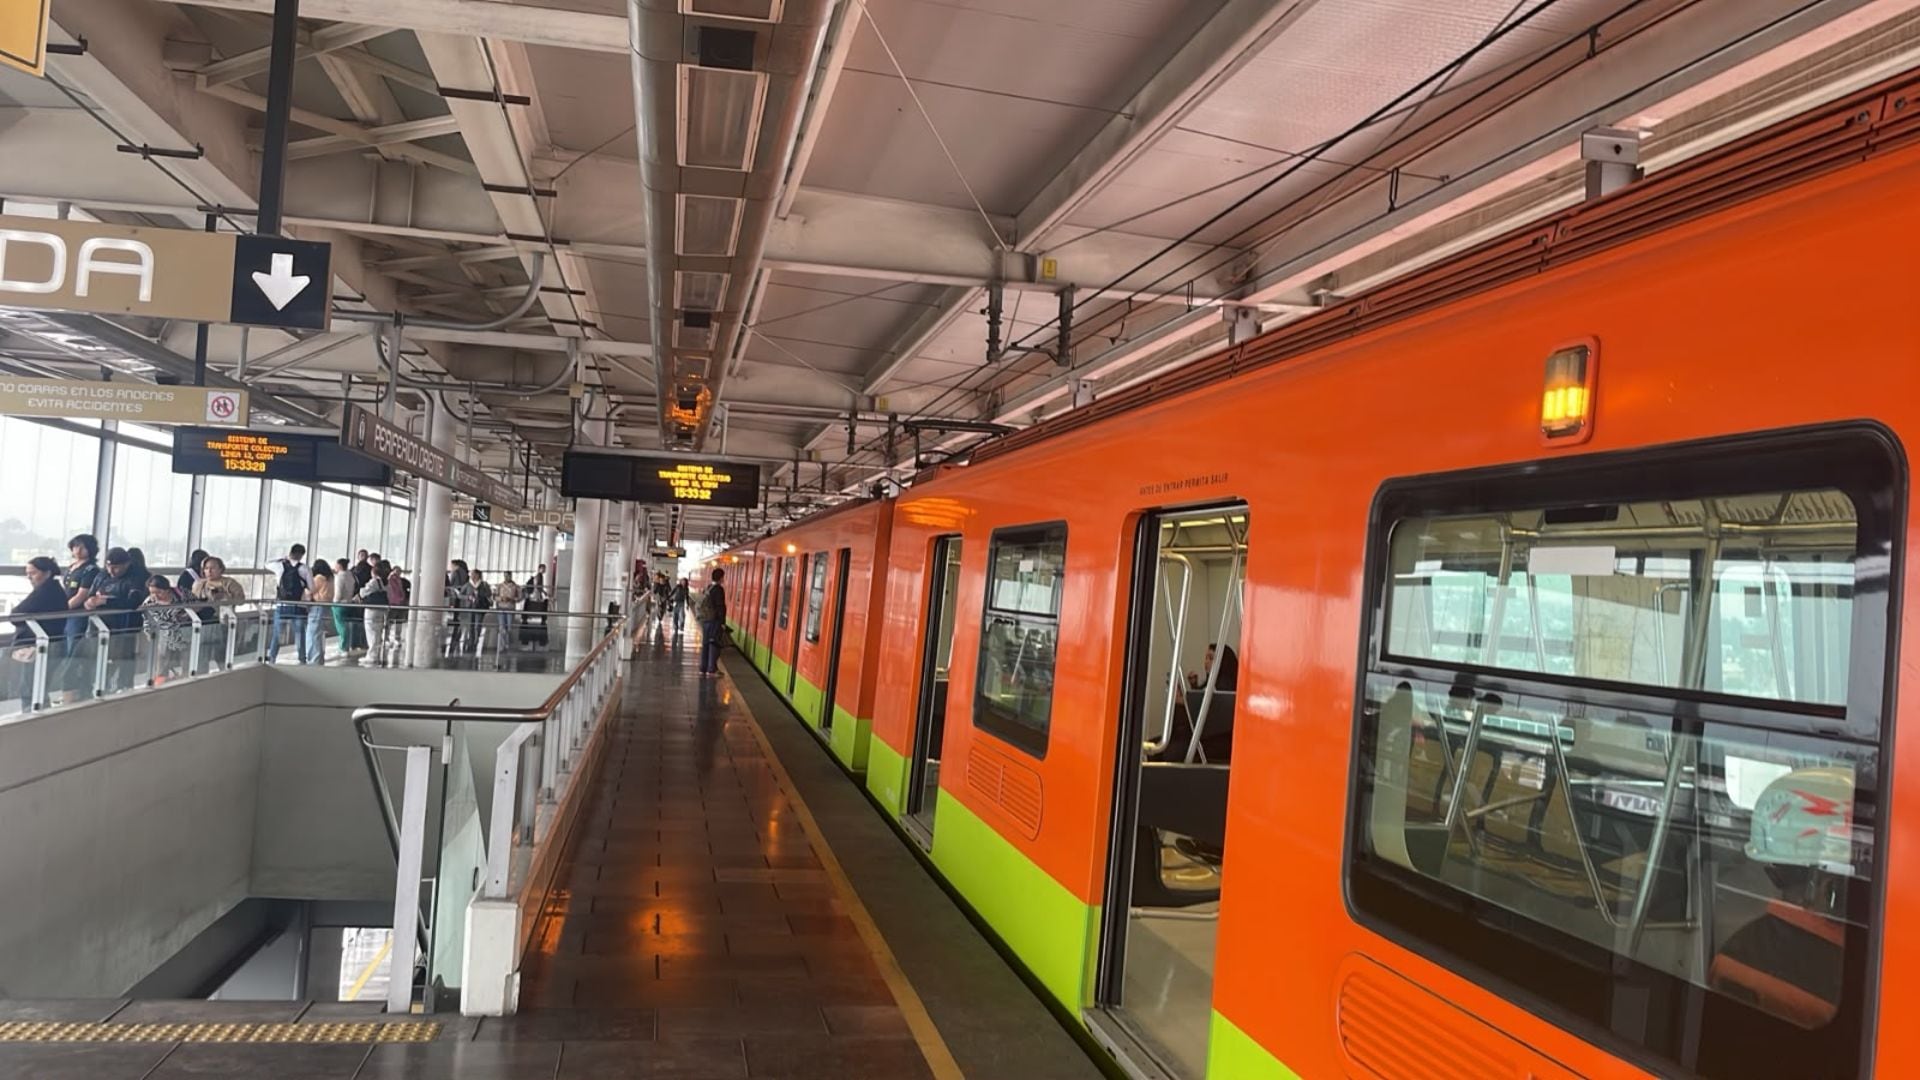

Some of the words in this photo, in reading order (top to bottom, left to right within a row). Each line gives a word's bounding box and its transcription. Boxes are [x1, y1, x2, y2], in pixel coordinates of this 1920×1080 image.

[0, 229, 154, 302] DA
[18, 384, 67, 396] CORRAS
[70, 386, 88, 397] EN
[90, 388, 114, 398] LOS
[117, 389, 175, 402] ANDENES
[28, 398, 63, 409] EVITA
[66, 399, 143, 413] ACCIDENTES
[504, 509, 576, 525] SALIDA
